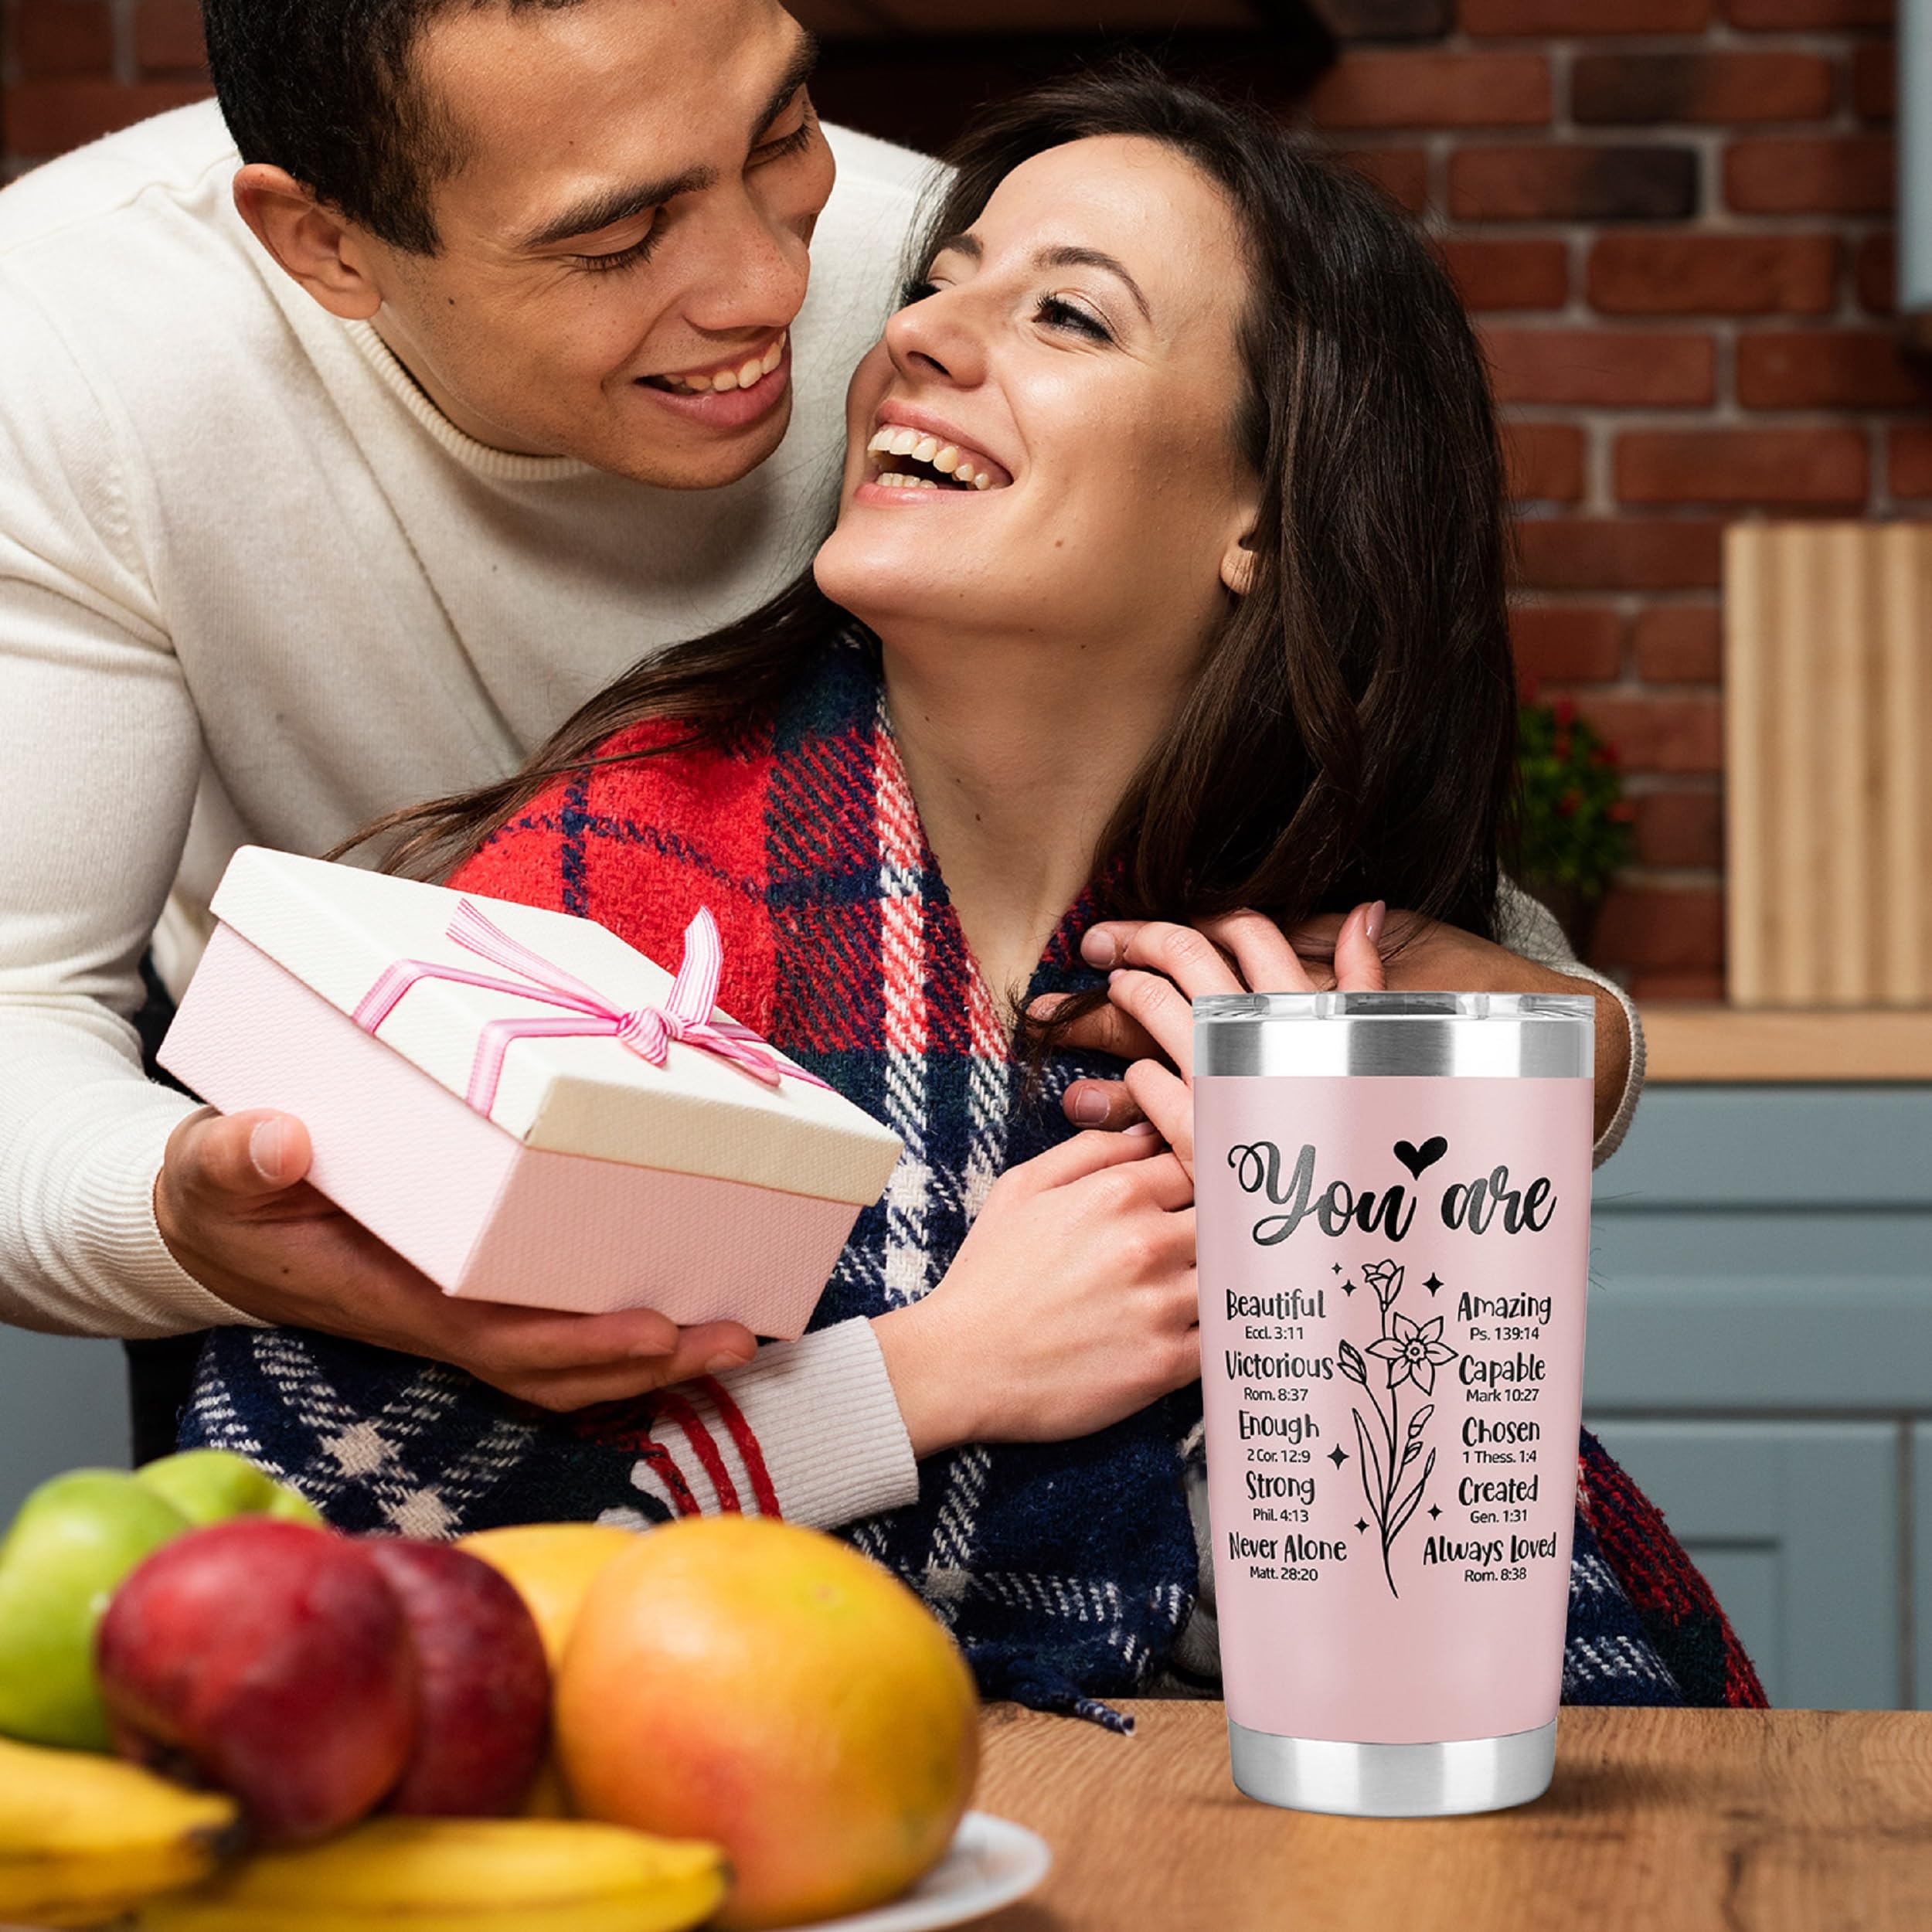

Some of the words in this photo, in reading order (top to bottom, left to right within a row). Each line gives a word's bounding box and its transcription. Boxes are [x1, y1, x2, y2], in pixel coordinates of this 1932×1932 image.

[1228, 1141, 1417, 1246] You
[1440, 1165, 1558, 1235] are
[1226, 1288, 1326, 1321] Beautiful
[1458, 1291, 1552, 1325] Amazing
[1245, 1325, 1272, 1340] Eccl.
[1274, 1326, 1304, 1340] 3:11
[1470, 1327, 1492, 1341] Ps.
[1495, 1326, 1539, 1341] 139:14
[1225, 1350, 1334, 1380] Victorious
[1458, 1352, 1546, 1389] Capable
[1243, 1386, 1276, 1401] Rom.
[1277, 1388, 1308, 1402] 8:37
[1466, 1388, 1502, 1403] Mark
[1504, 1388, 1540, 1402] 10:27
[1238, 1410, 1320, 1445] Enough
[1461, 1416, 1540, 1447] Chosen
[1247, 1448, 1255, 1461] 2
[1257, 1448, 1279, 1463] Cor.
[1281, 1450, 1311, 1463] 12:9
[1462, 1451, 1470, 1464] 1
[1474, 1450, 1516, 1464] Thess.
[1519, 1450, 1537, 1463] 1:4
[1246, 1470, 1315, 1505] Strong
[1458, 1474, 1539, 1506] Created
[1253, 1508, 1279, 1522] Phil.
[1280, 1509, 1309, 1523] 4:13
[1470, 1510, 1500, 1524] Gen.
[1502, 1509, 1528, 1522] 1:31
[1229, 1531, 1279, 1560] Never
[1284, 1533, 1348, 1563] Alone
[1423, 1535, 1504, 1567] Always
[1510, 1531, 1556, 1563] Loved
[1250, 1566, 1280, 1580] Matt.
[1281, 1566, 1318, 1581] 28:20
[1464, 1568, 1499, 1583] Rom.
[1500, 1566, 1527, 1581] 8:38
